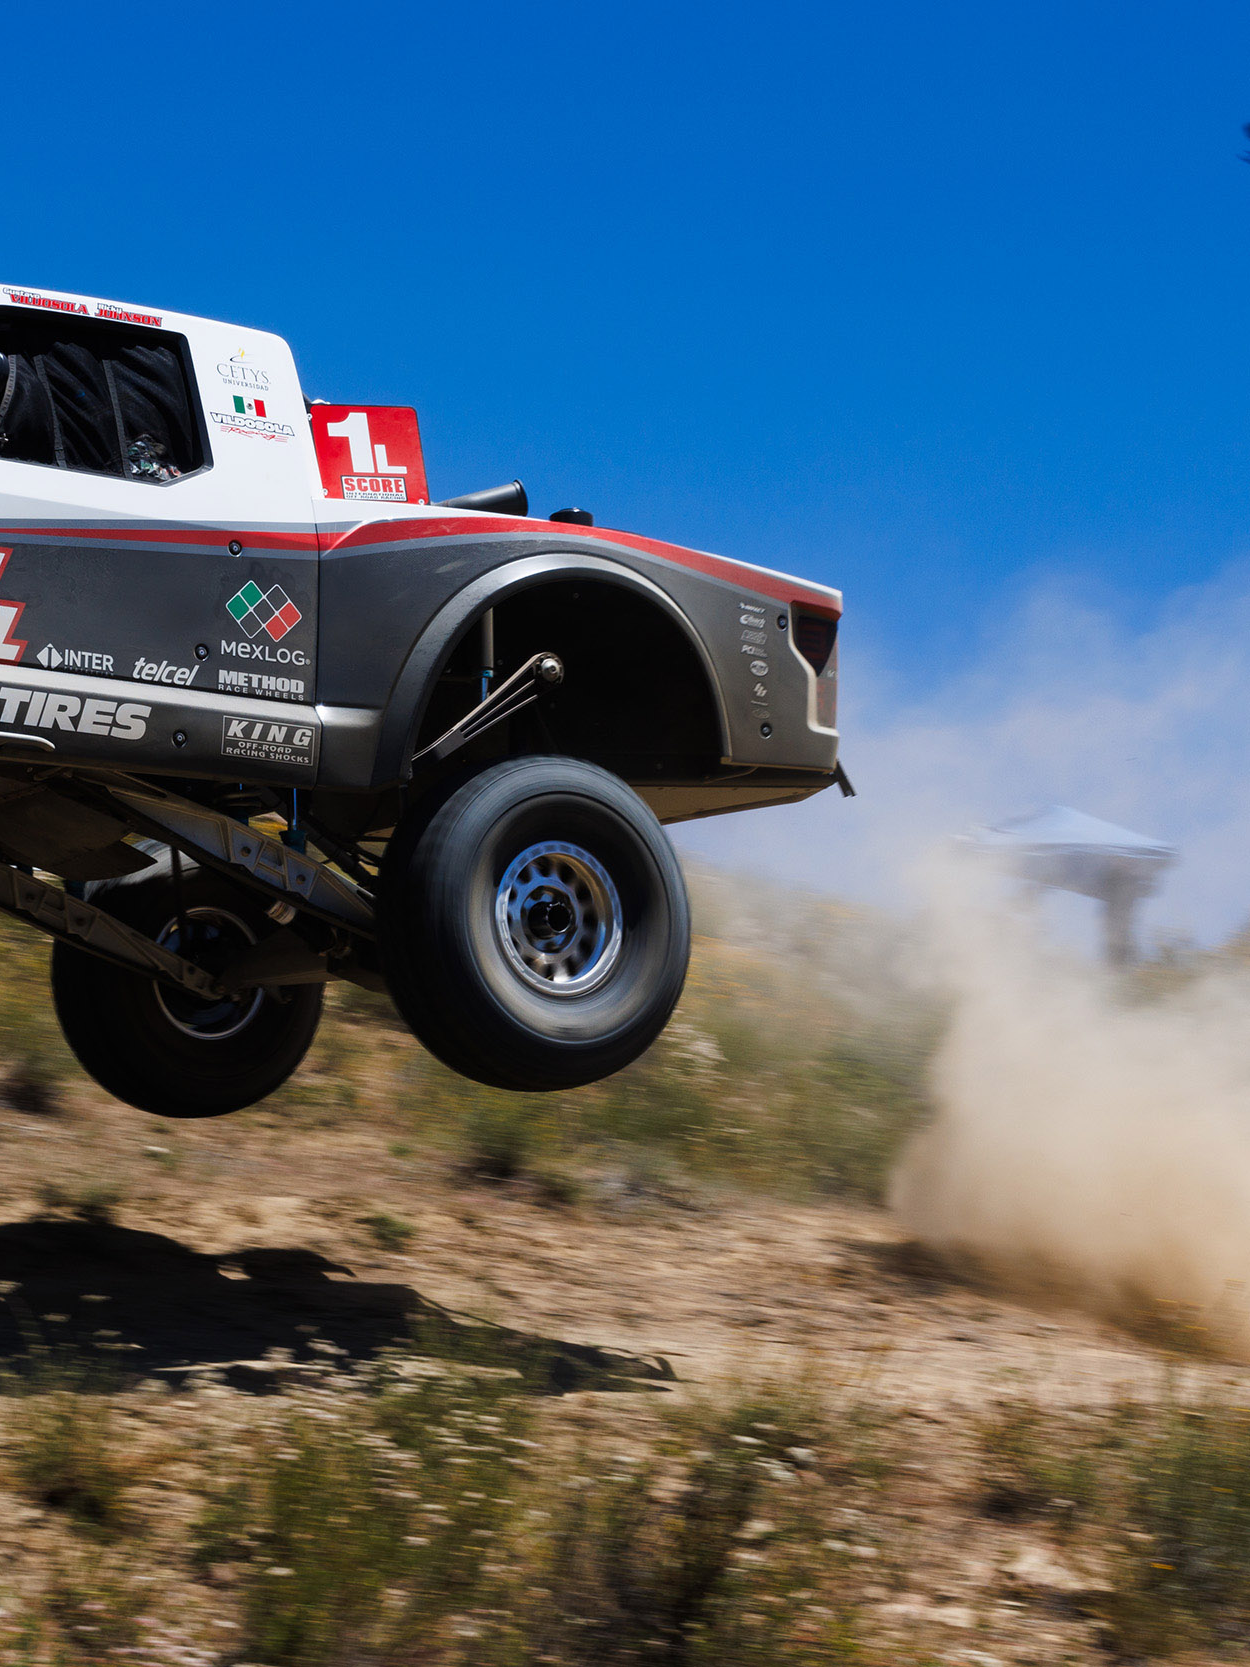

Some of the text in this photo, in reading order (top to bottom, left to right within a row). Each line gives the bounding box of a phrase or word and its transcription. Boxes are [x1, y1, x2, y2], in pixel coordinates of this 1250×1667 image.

[9, 294, 163, 328] VILDOSOLA JOHNSON
[216, 363, 270, 384] CETYS
[222, 377, 270, 392] UNIVERSIDAD
[210, 411, 295, 437] VILDOSOLA
[326, 412, 408, 475] 1L
[344, 478, 404, 493] SCORE
[64, 648, 115, 672] INTER
[132, 657, 200, 686] telcel
[218, 669, 305, 695] METHOD
[218, 683, 305, 702] RACE WHEELS
[226, 719, 313, 746] KING
[226, 746, 310, 764] RACING SHOCKS
[238, 740, 293, 755] OFF-ROAD
